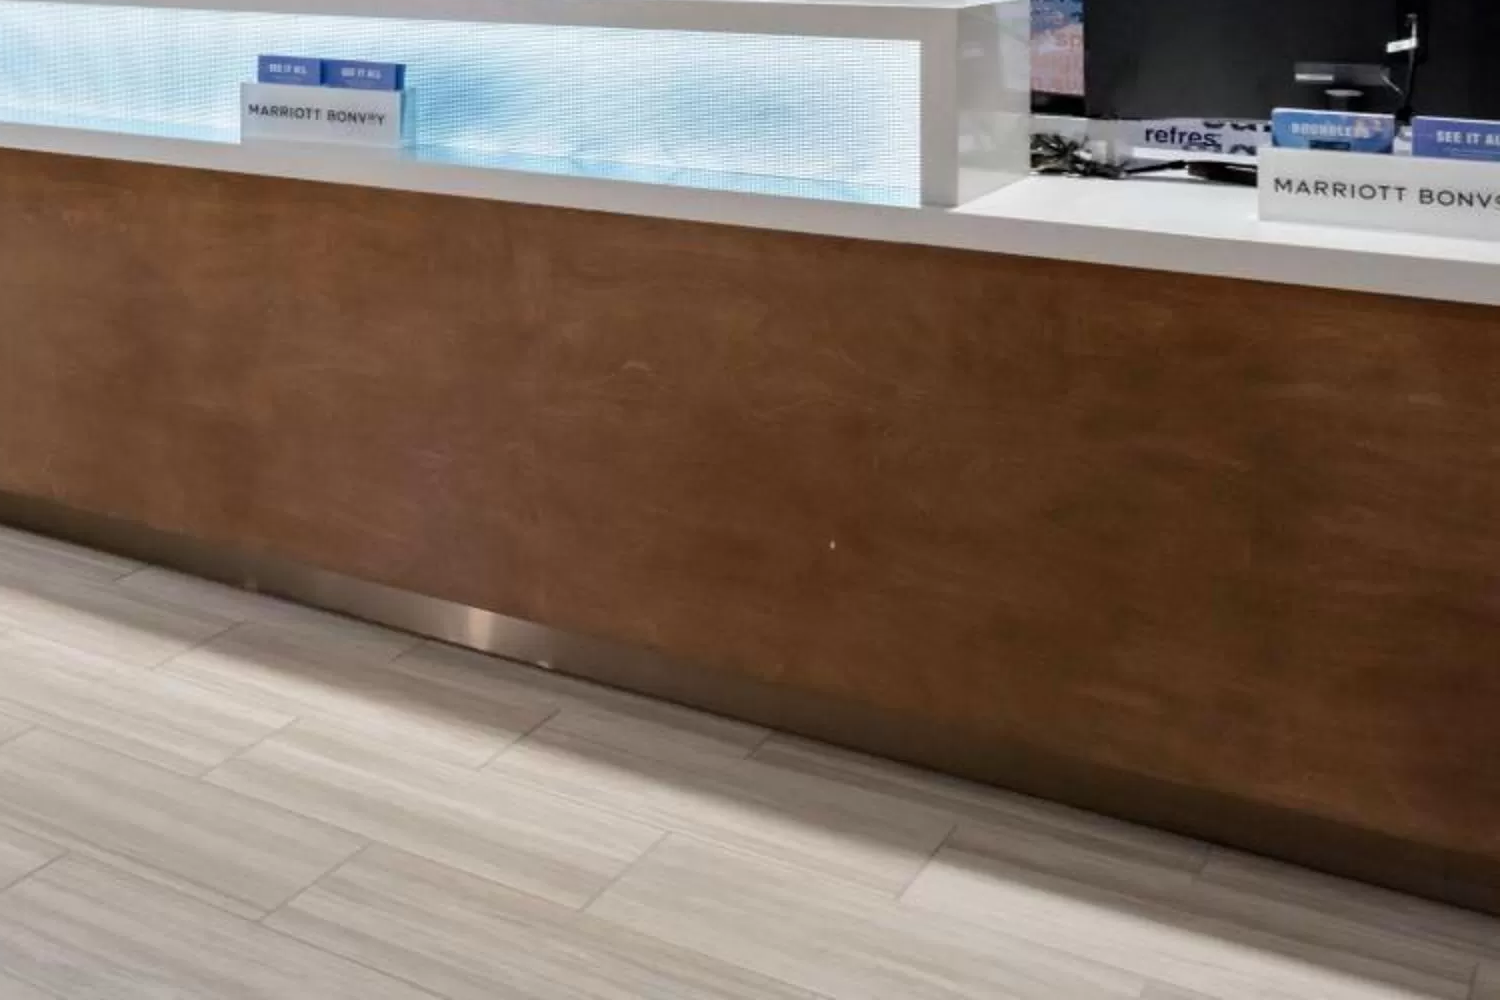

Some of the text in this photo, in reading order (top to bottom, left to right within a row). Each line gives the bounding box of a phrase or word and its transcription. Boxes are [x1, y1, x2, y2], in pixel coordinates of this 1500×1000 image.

[248, 104, 322, 122] MARRIOTT
[1436, 130, 1462, 144] SEE
[1466, 131, 1482, 145] IT
[1273, 177, 1408, 202] MARRIOTT
